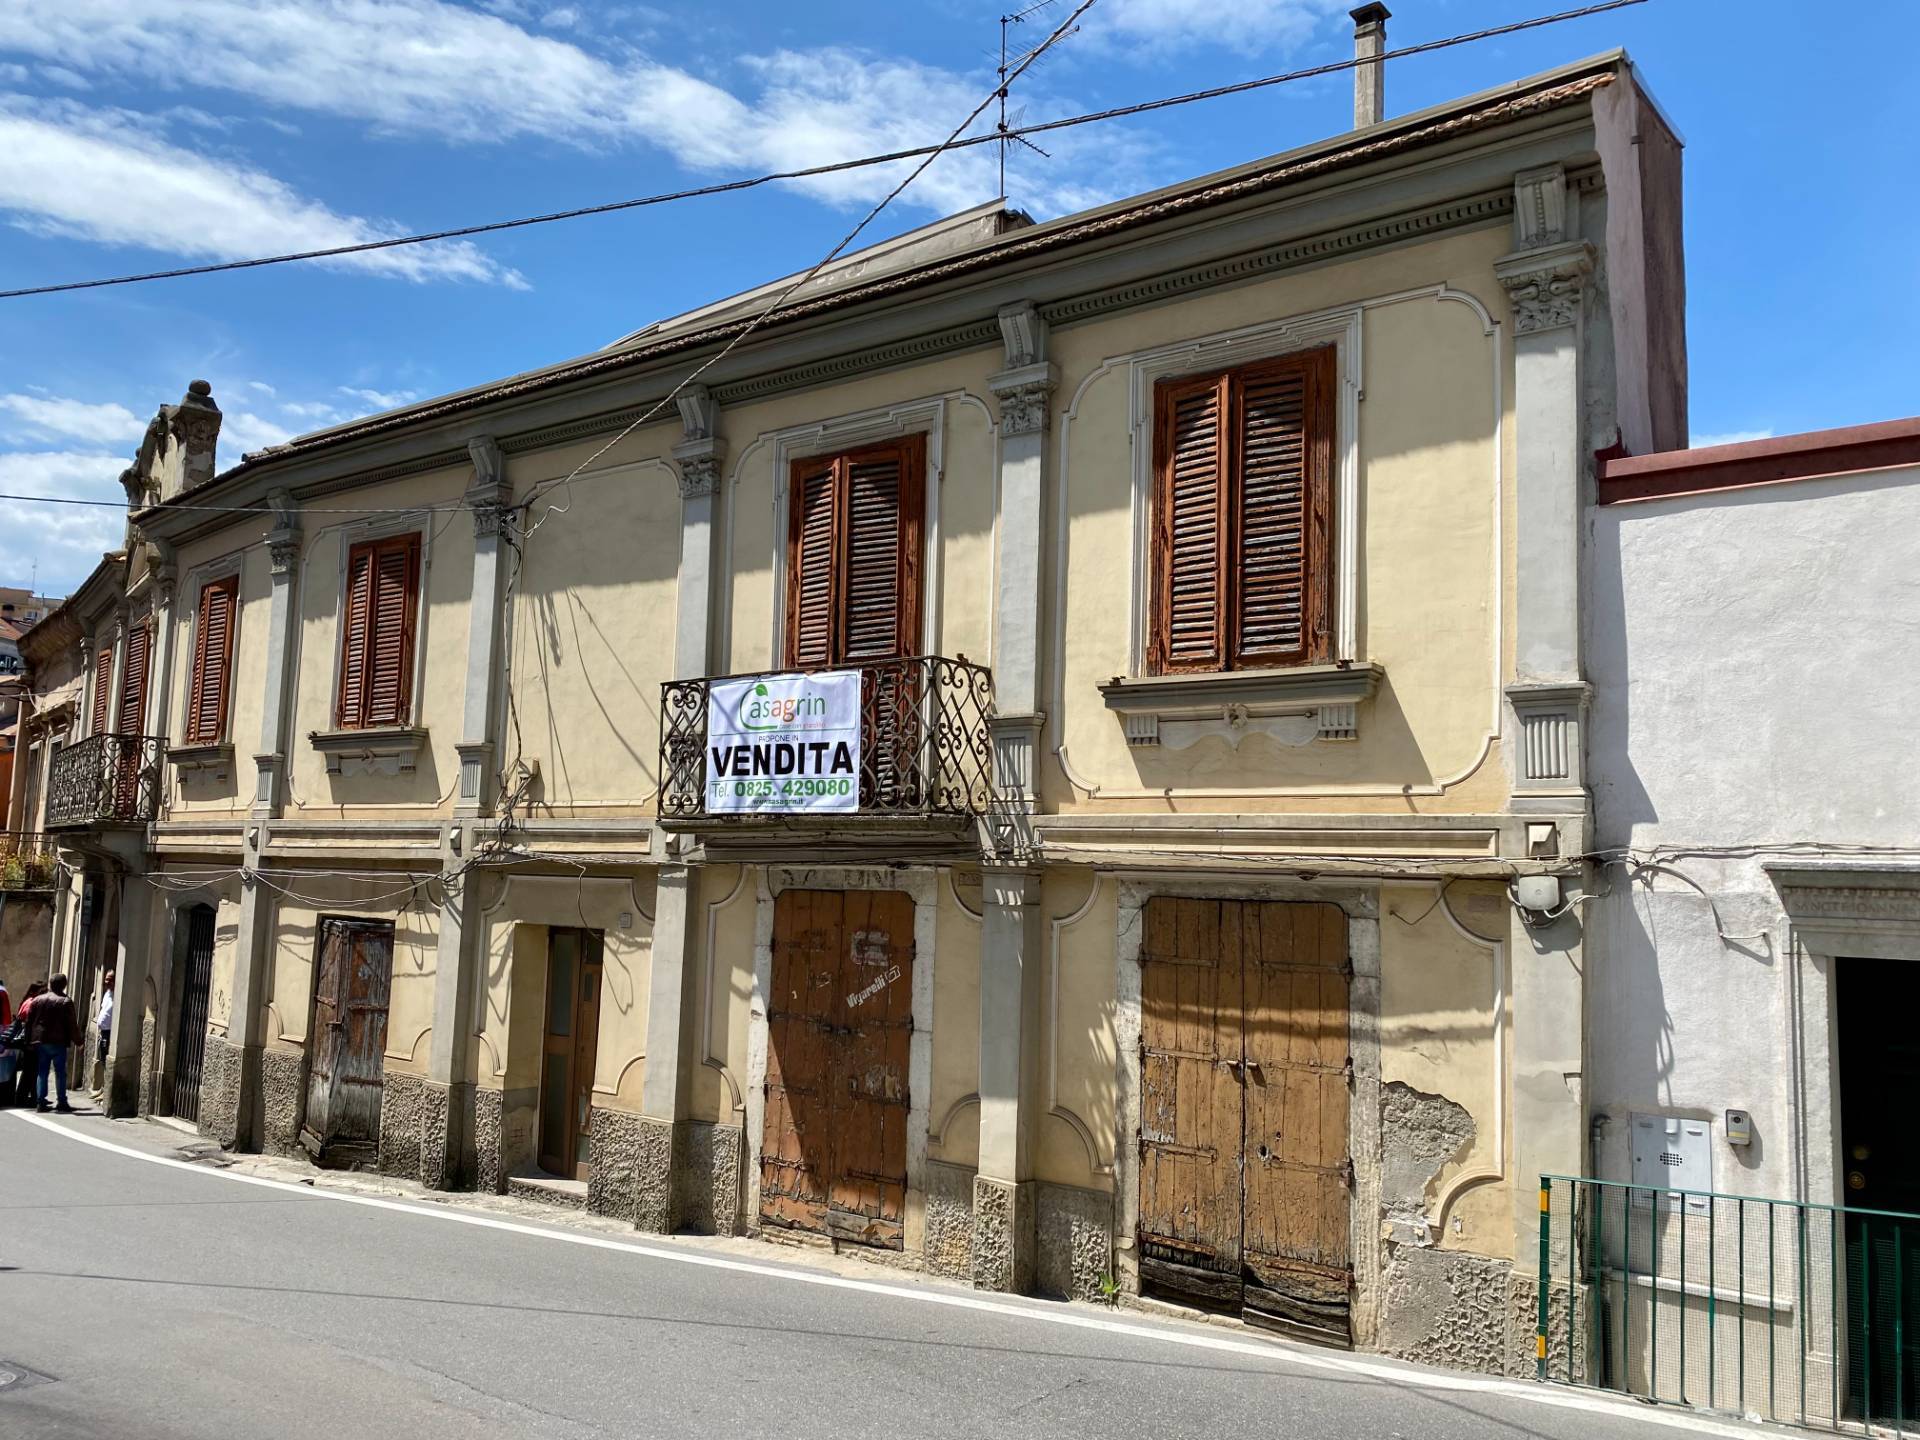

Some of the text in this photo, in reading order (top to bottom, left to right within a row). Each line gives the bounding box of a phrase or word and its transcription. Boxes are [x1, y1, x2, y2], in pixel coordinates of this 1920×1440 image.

[758, 735, 790, 743] PROPONE
[711, 741, 854, 777] VENDITA
[711, 779, 850, 798] Tel. 0825. 429080
